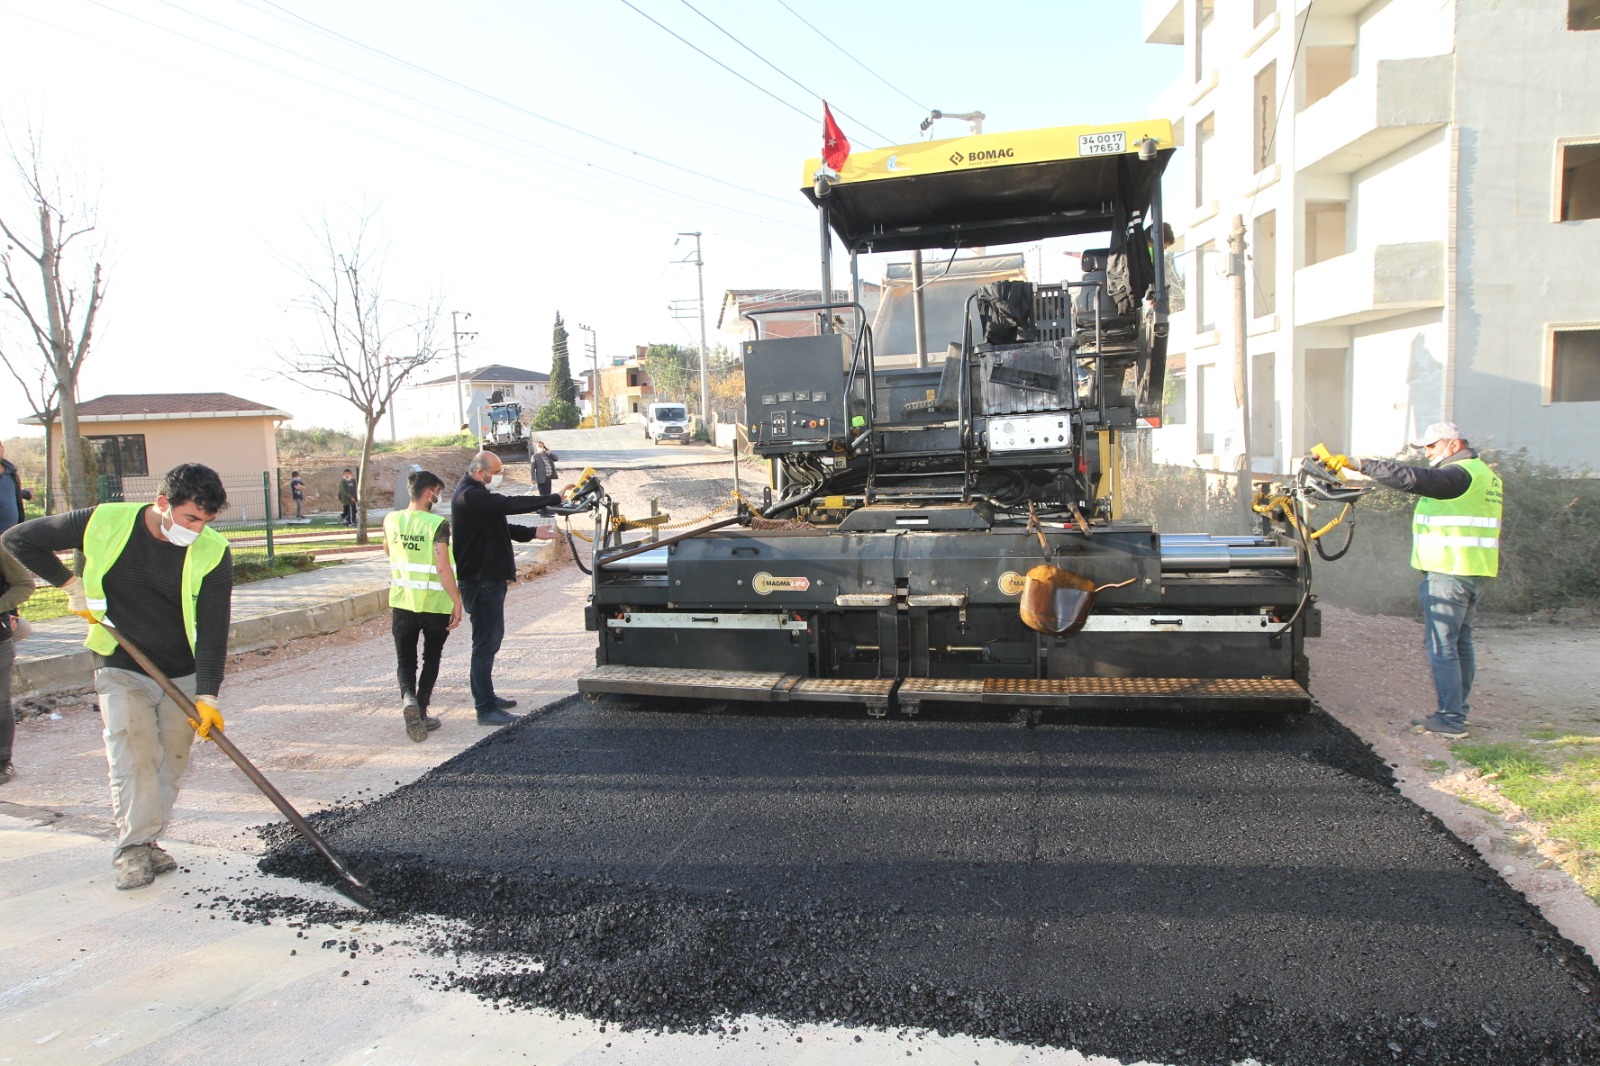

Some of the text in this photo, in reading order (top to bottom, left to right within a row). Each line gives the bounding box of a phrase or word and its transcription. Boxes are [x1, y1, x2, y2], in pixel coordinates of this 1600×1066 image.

[1082, 136, 1095, 145] 34
[1089, 143, 1120, 153] 17653
[968, 148, 1014, 162] BOMAG
[402, 542, 421, 551] YOL
